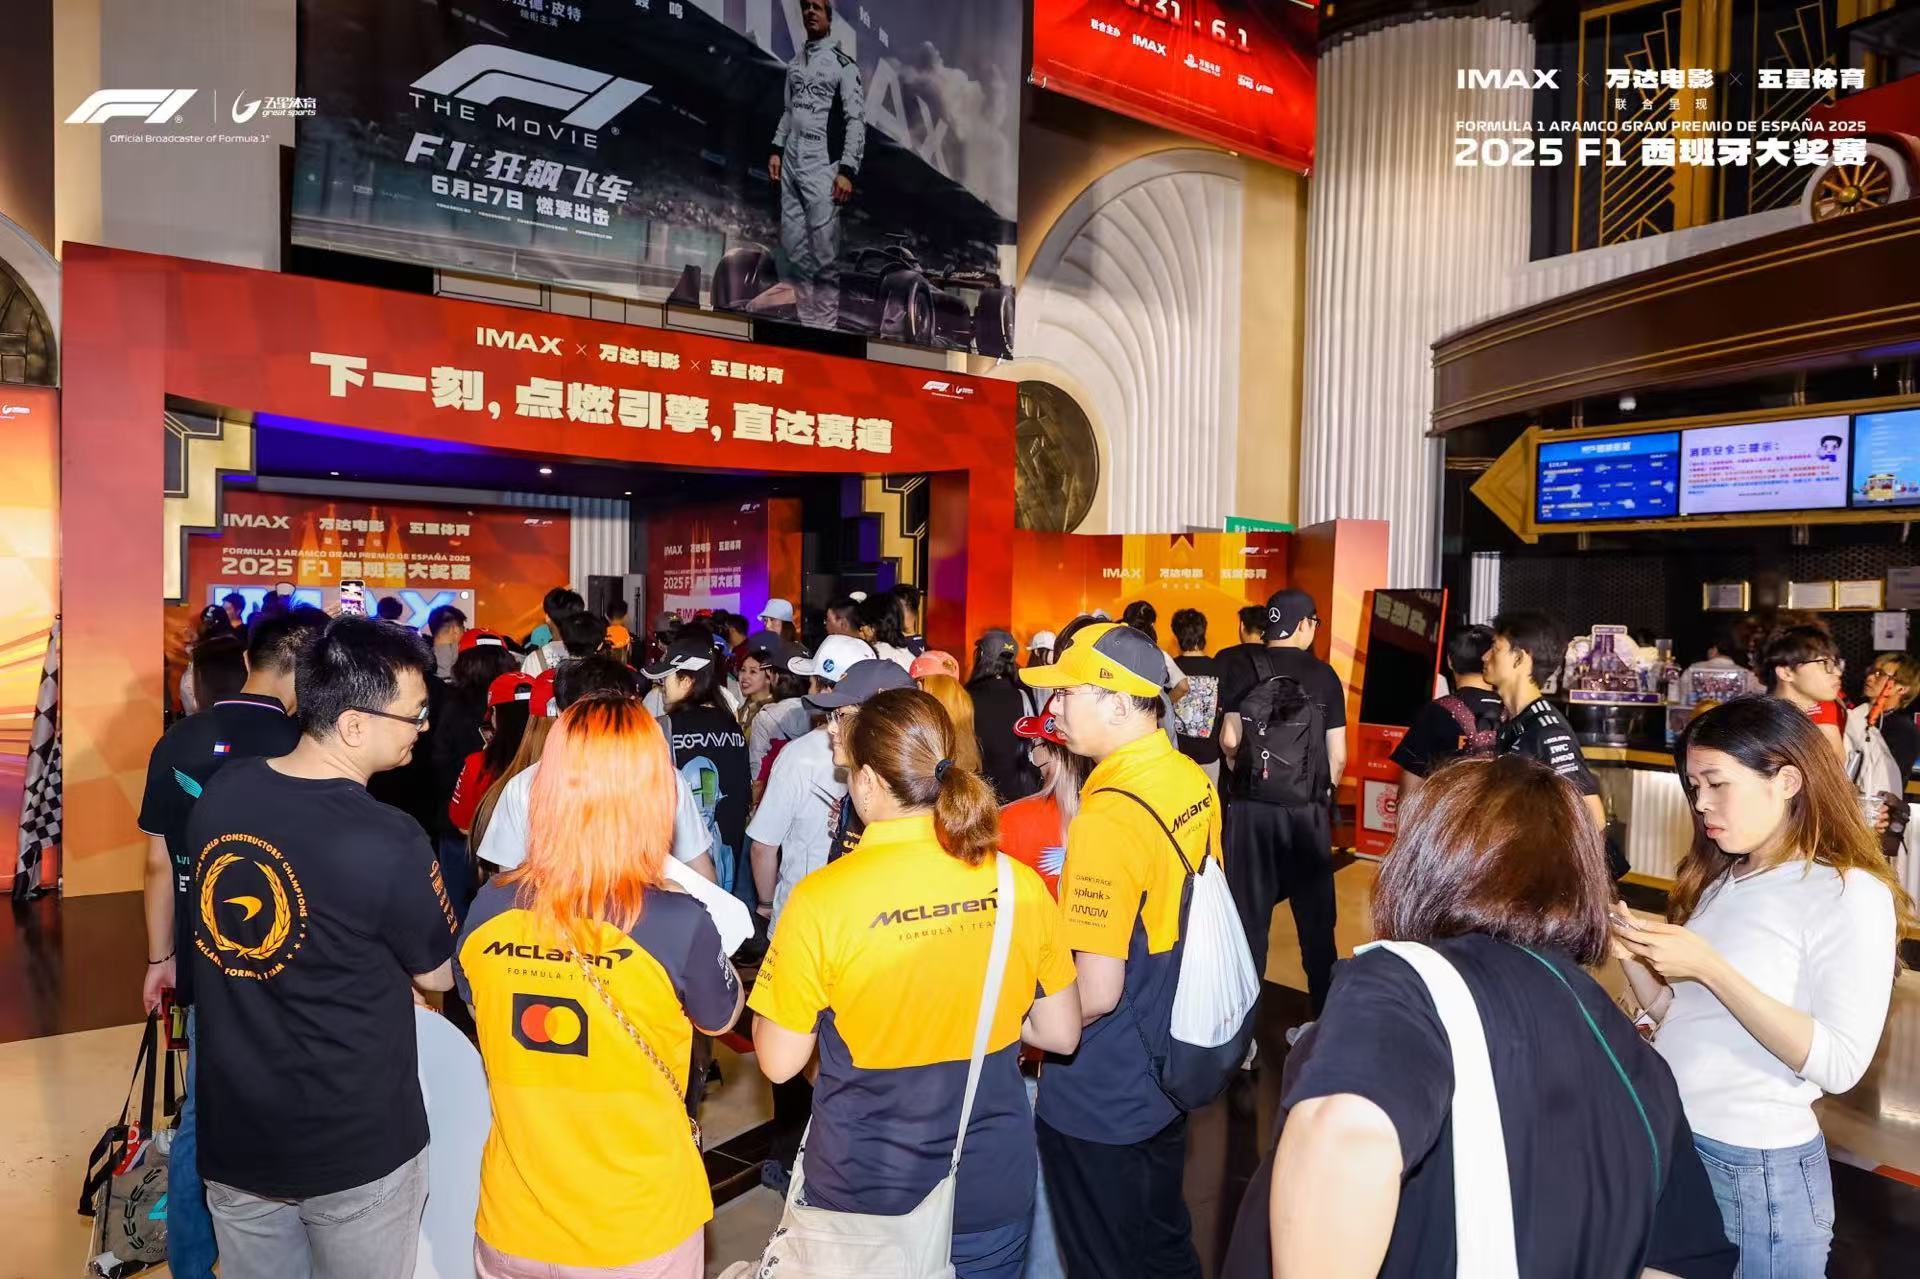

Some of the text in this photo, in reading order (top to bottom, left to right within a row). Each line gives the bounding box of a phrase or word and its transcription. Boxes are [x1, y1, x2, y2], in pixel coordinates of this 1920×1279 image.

[1132, 33, 1167, 57] IMAX
[1211, 18, 1250, 53] 6.1
[408, 92, 598, 150] THE MOVIE
[431, 174, 524, 211] 6月27日
[536, 195, 610, 227] 燃擎出击
[476, 327, 564, 357] IMAX
[598, 344, 681, 371] 万达电影
[710, 359, 784, 385] 五星体育
[223, 513, 471, 536] IMAX 万达电影 五星体育
[223, 548, 273, 556] FORMULA
[284, 549, 325, 558] ARAMCO
[359, 552, 395, 560] PREMIO
[412, 552, 447, 562] ESPAÑA
[222, 557, 293, 576] 2025
[302, 559, 332, 577] F1
[1103, 568, 1141, 579] IMAX
[664, 577, 684, 590] 2025
[282, 861, 308, 917] CHAMPIONS
[869, 896, 998, 929] McLaren
[899, 927, 953, 941] FORMULA
[972, 921, 997, 930] TEA
[507, 967, 561, 980] FORMULA
